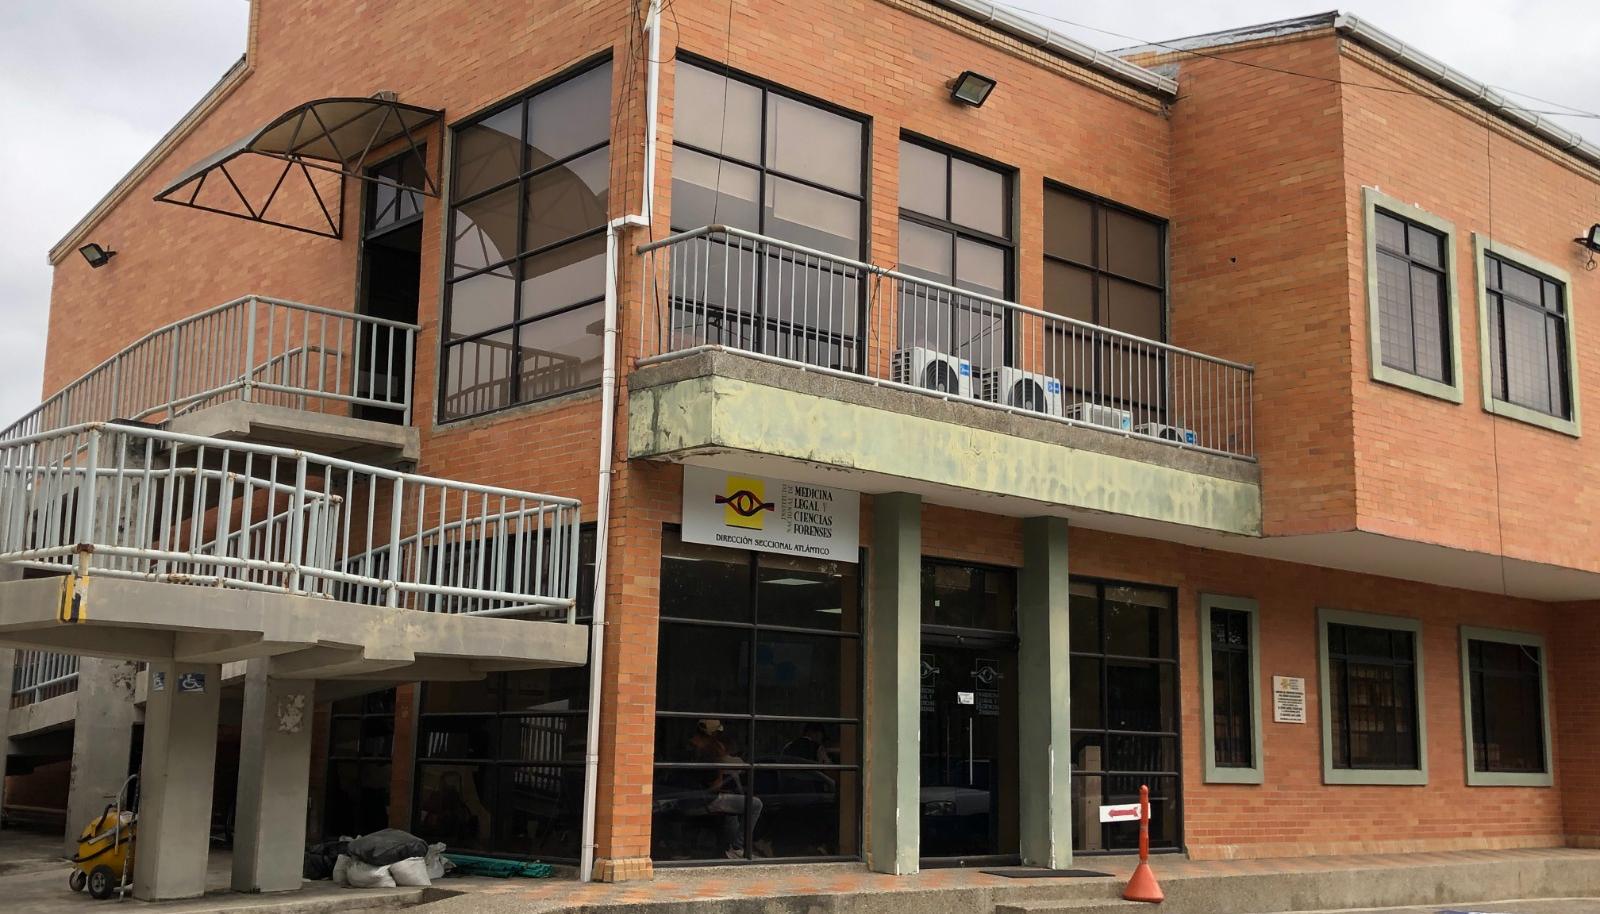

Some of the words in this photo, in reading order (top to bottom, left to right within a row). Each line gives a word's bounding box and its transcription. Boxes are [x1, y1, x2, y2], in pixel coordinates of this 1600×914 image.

[794, 486, 833, 501] MEDICINA
[794, 498, 820, 512] LEGAL
[793, 511, 833, 526] CIENCIAS
[793, 524, 832, 538] FORENSES
[715, 533, 753, 546] DIRECCIÓN
[754, 538, 792, 551] SECCIONAL
[793, 543, 830, 556] ATLÁNTICO
